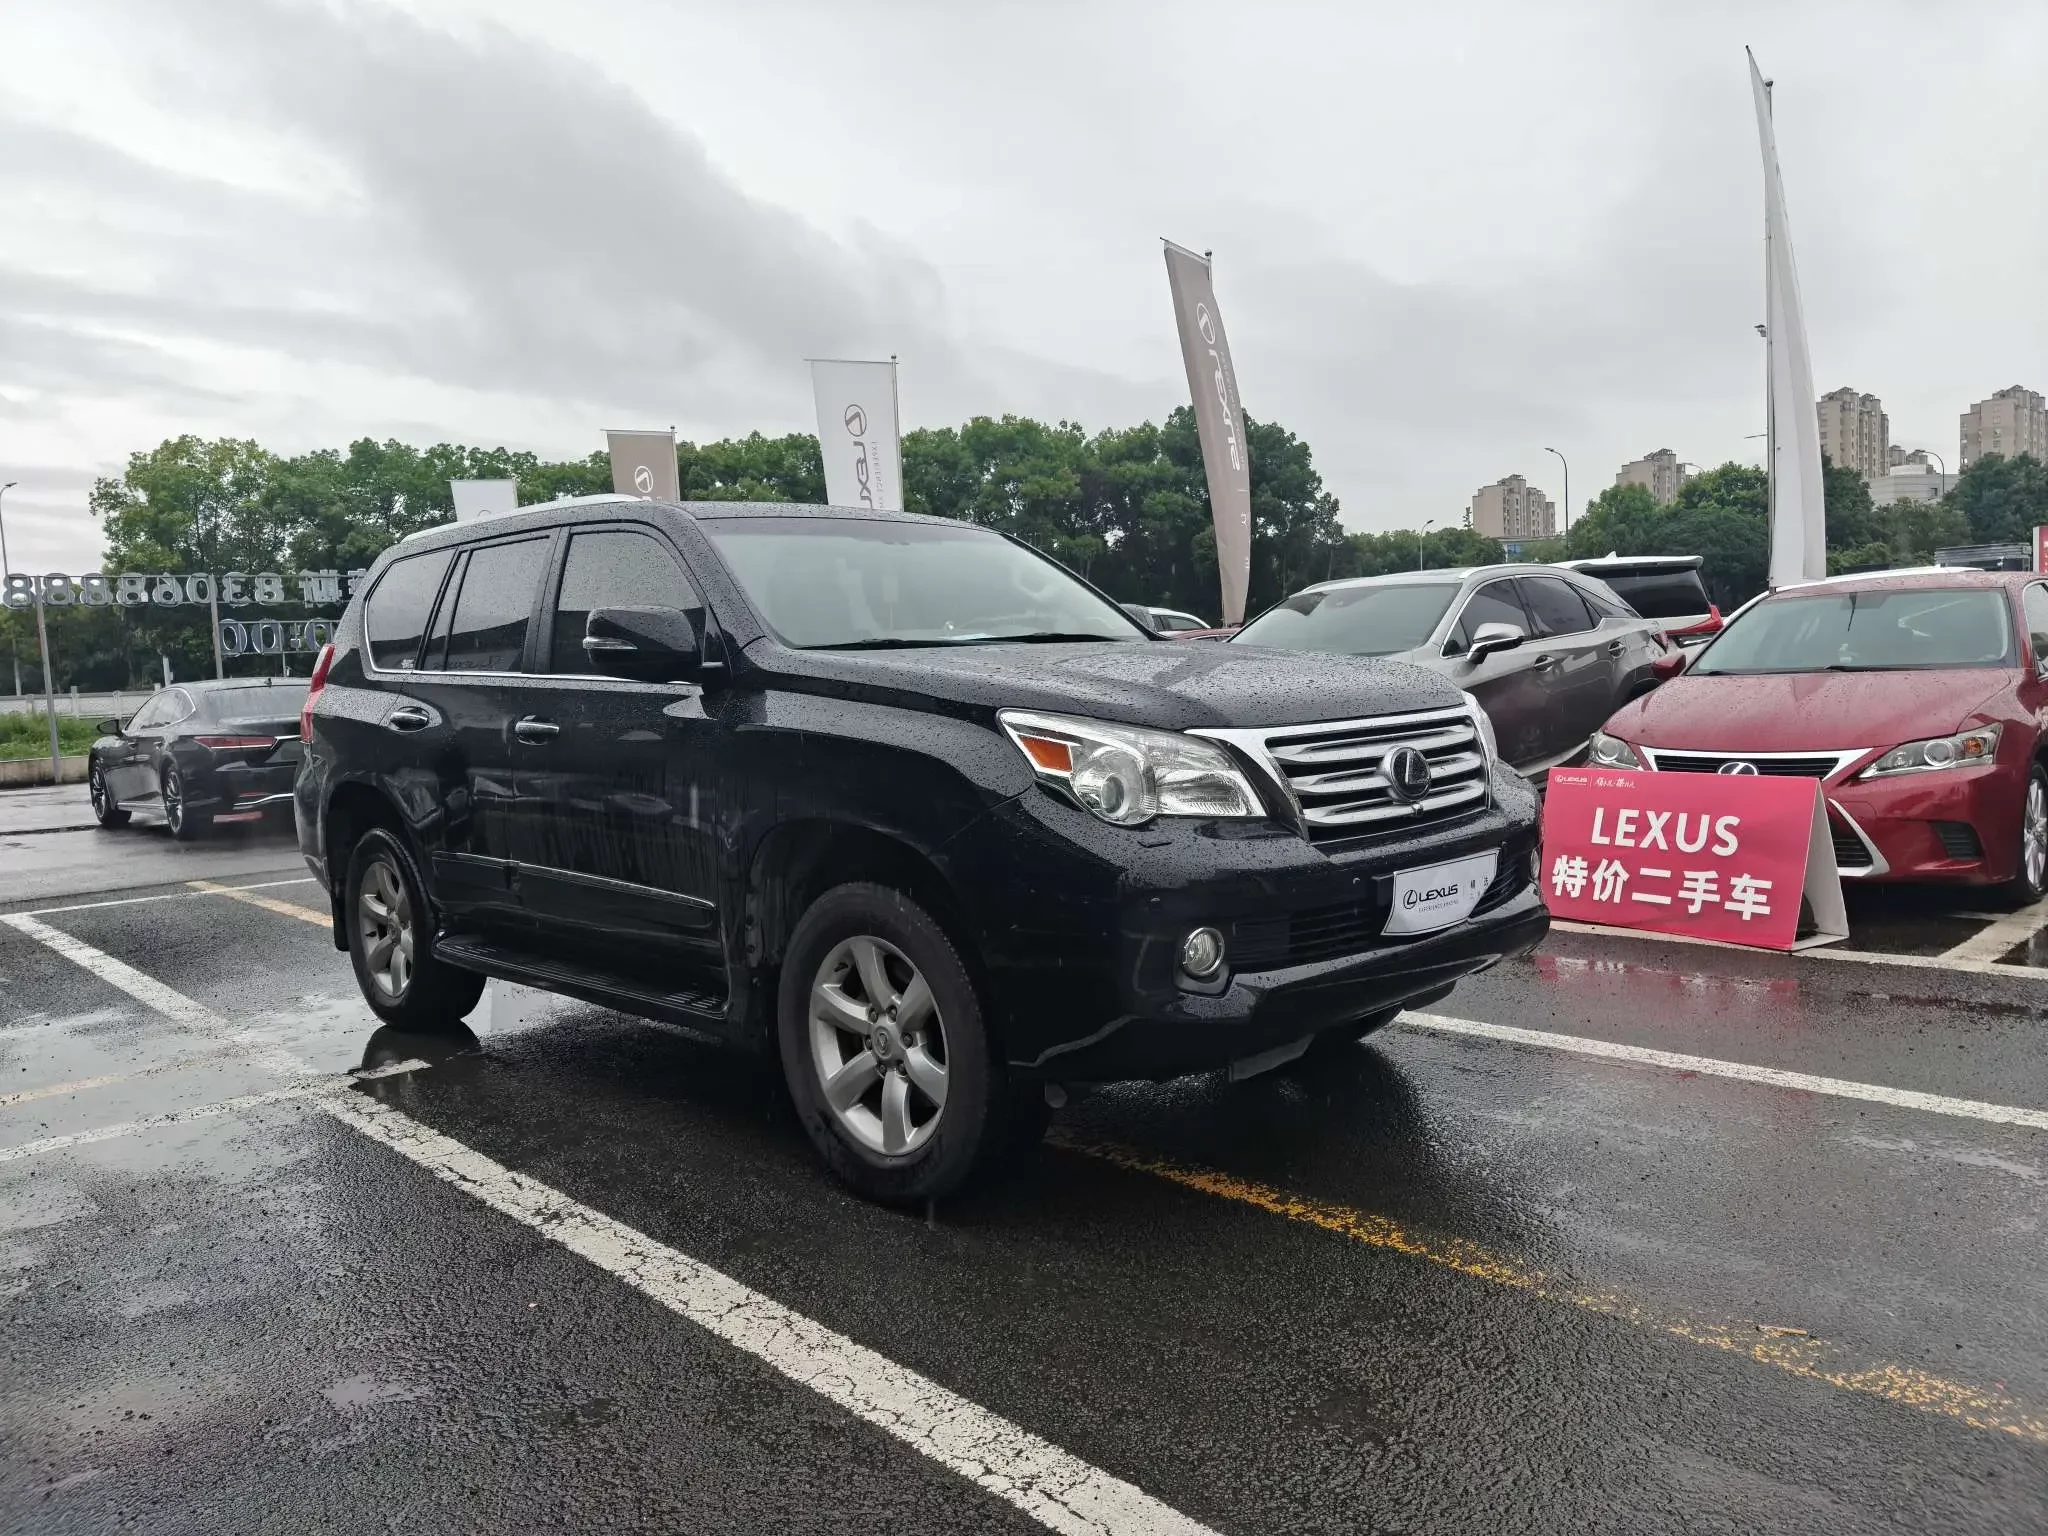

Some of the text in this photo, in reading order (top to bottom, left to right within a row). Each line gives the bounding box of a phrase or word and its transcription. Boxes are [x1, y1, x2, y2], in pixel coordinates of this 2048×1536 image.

[1591, 807, 1741, 857] LEXUS
[1418, 883, 1458, 903] LEXUS
[1552, 854, 1773, 921] 特价二手车
